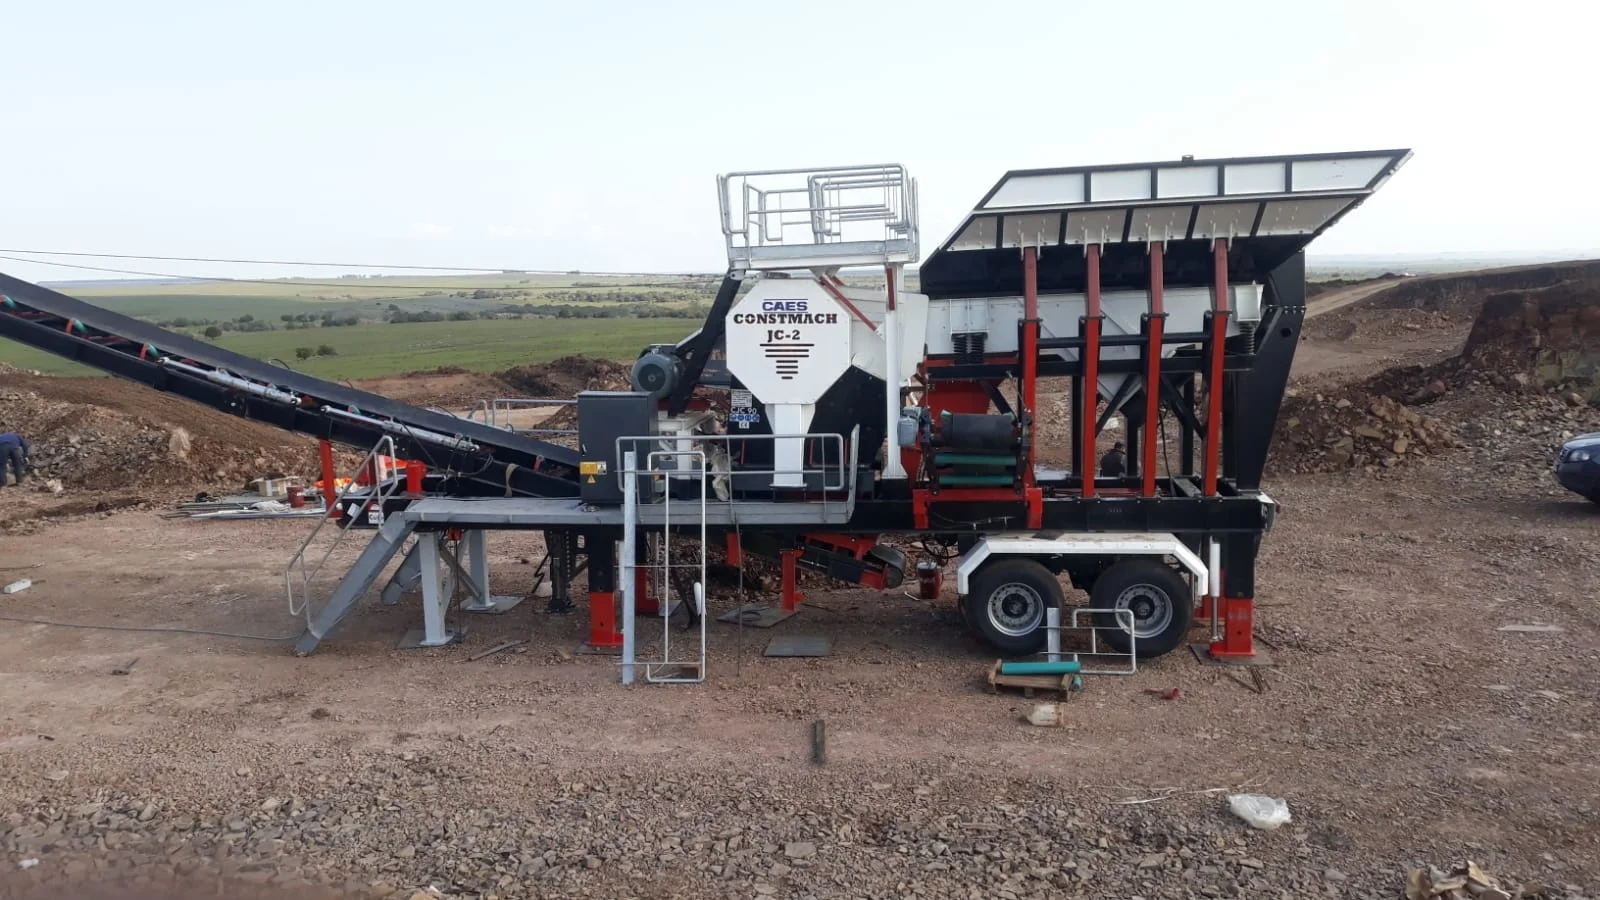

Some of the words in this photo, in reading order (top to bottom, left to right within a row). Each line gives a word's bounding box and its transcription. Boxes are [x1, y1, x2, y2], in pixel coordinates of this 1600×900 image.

[762, 301, 808, 311] CAES
[733, 313, 837, 324] CONSTMACH
[767, 329, 801, 342] JC-2
